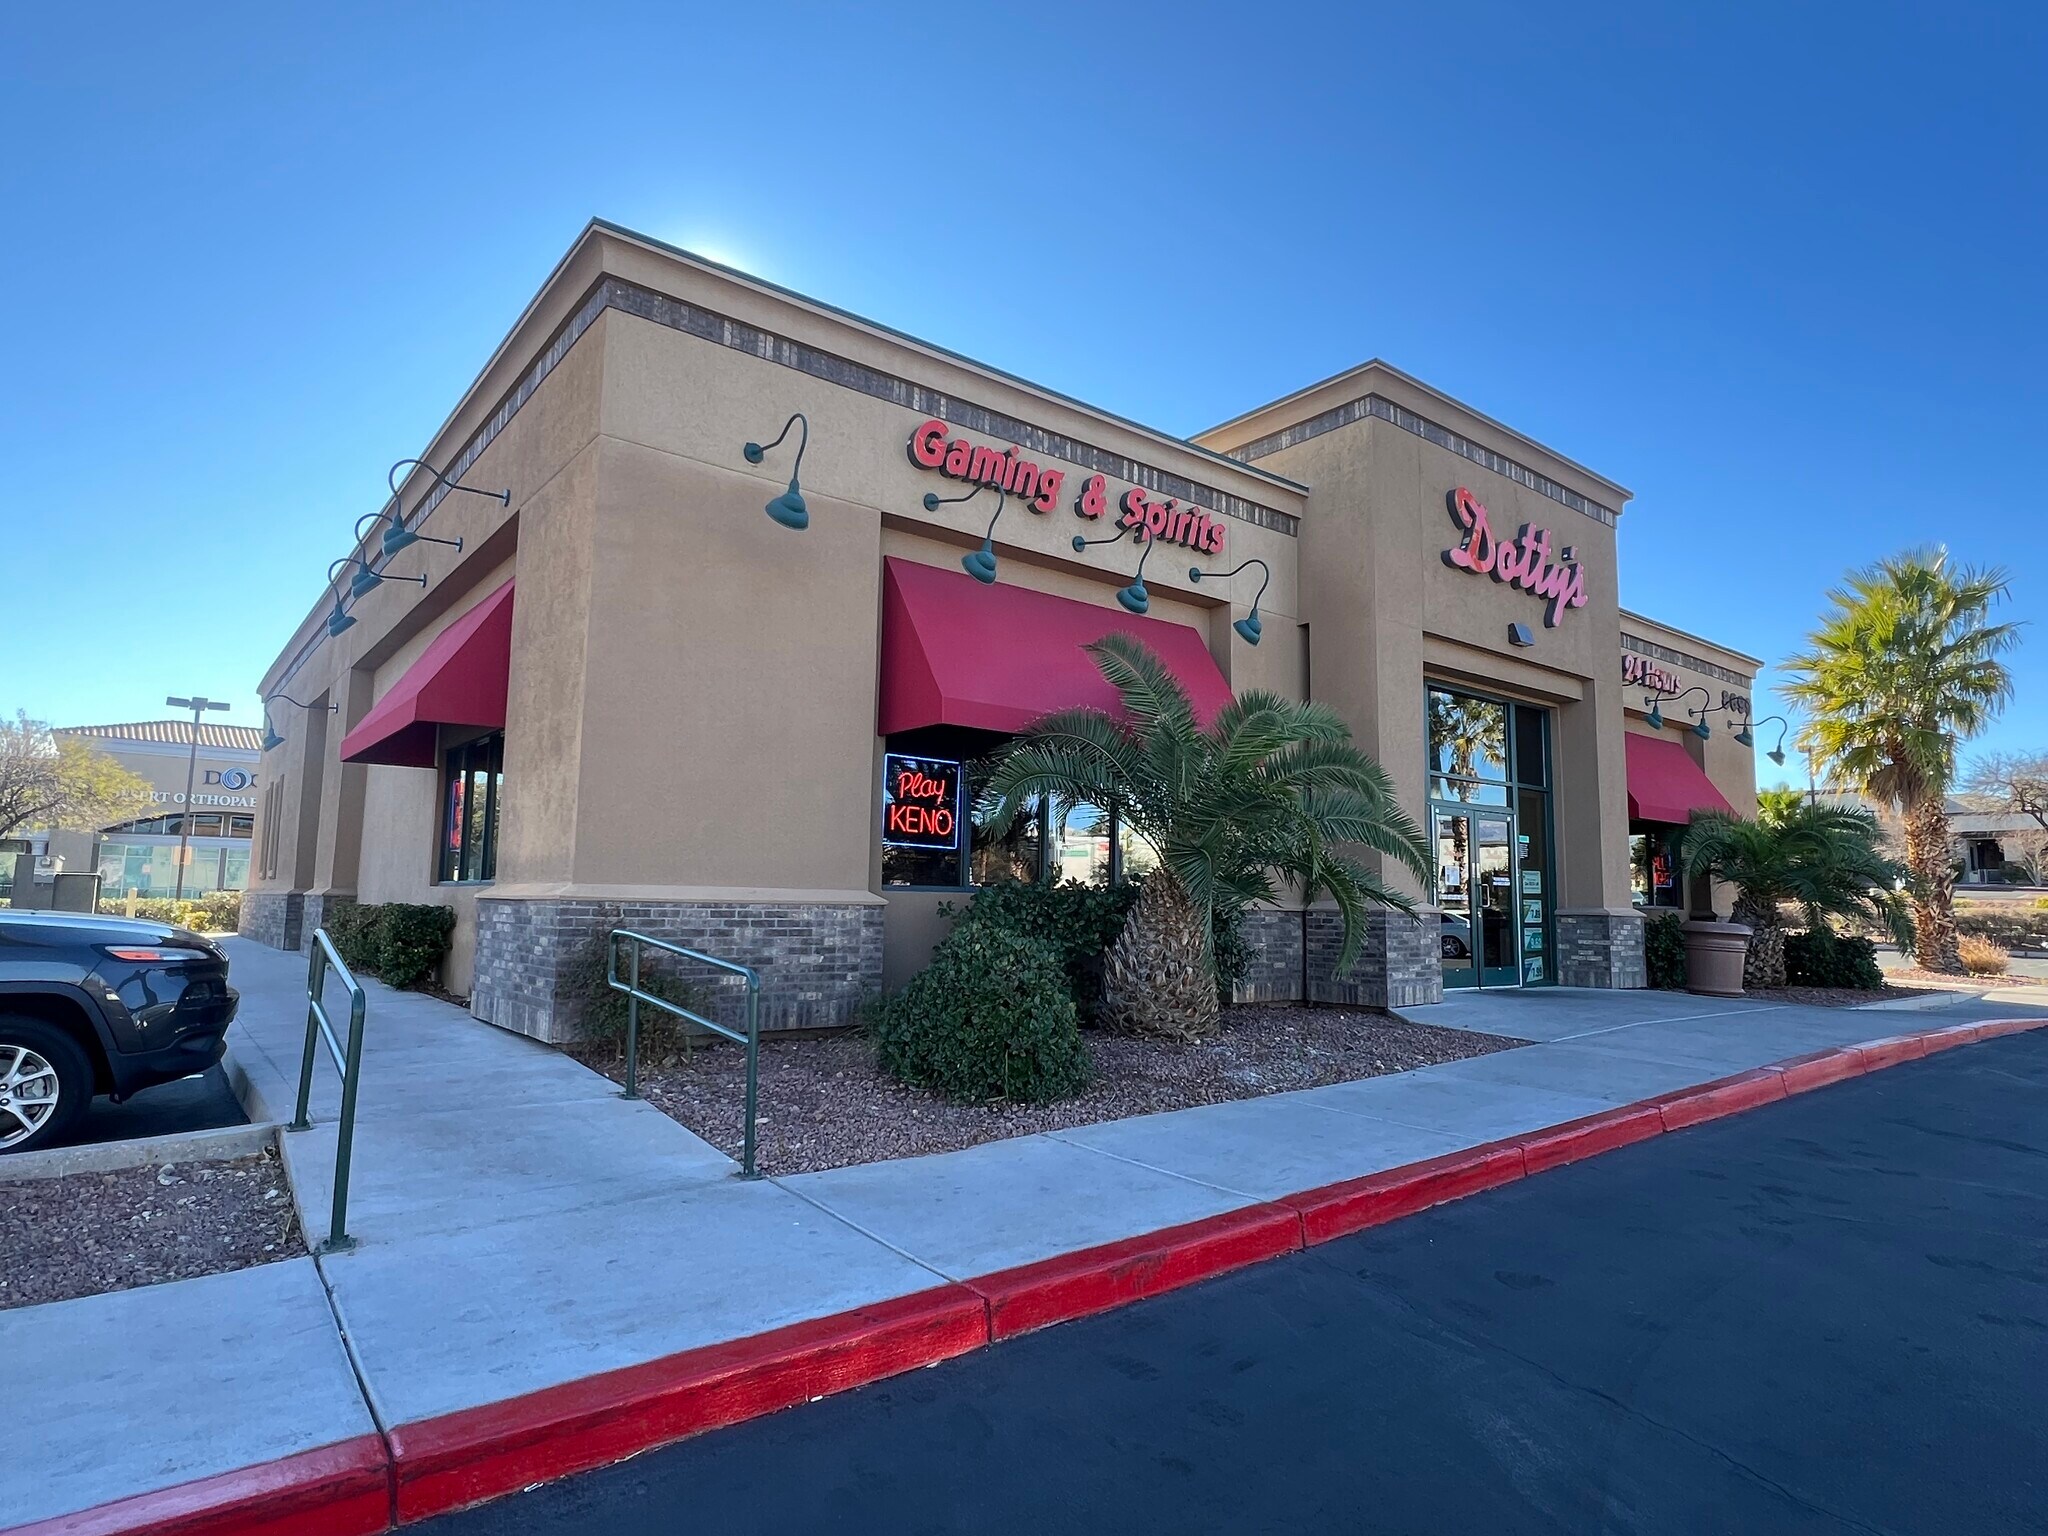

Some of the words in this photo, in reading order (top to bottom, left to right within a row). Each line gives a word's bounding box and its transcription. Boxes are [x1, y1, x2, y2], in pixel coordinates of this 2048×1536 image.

[908, 420, 1065, 514] Gaming
[1075, 474, 1107, 520] &
[1117, 487, 1226, 555] Spirits
[1442, 487, 1588, 627] Dotty's
[1622, 654, 1643, 682] 24
[1642, 661, 1682, 694] Hours
[898, 772, 945, 804] Play
[890, 804, 952, 835] KENO
